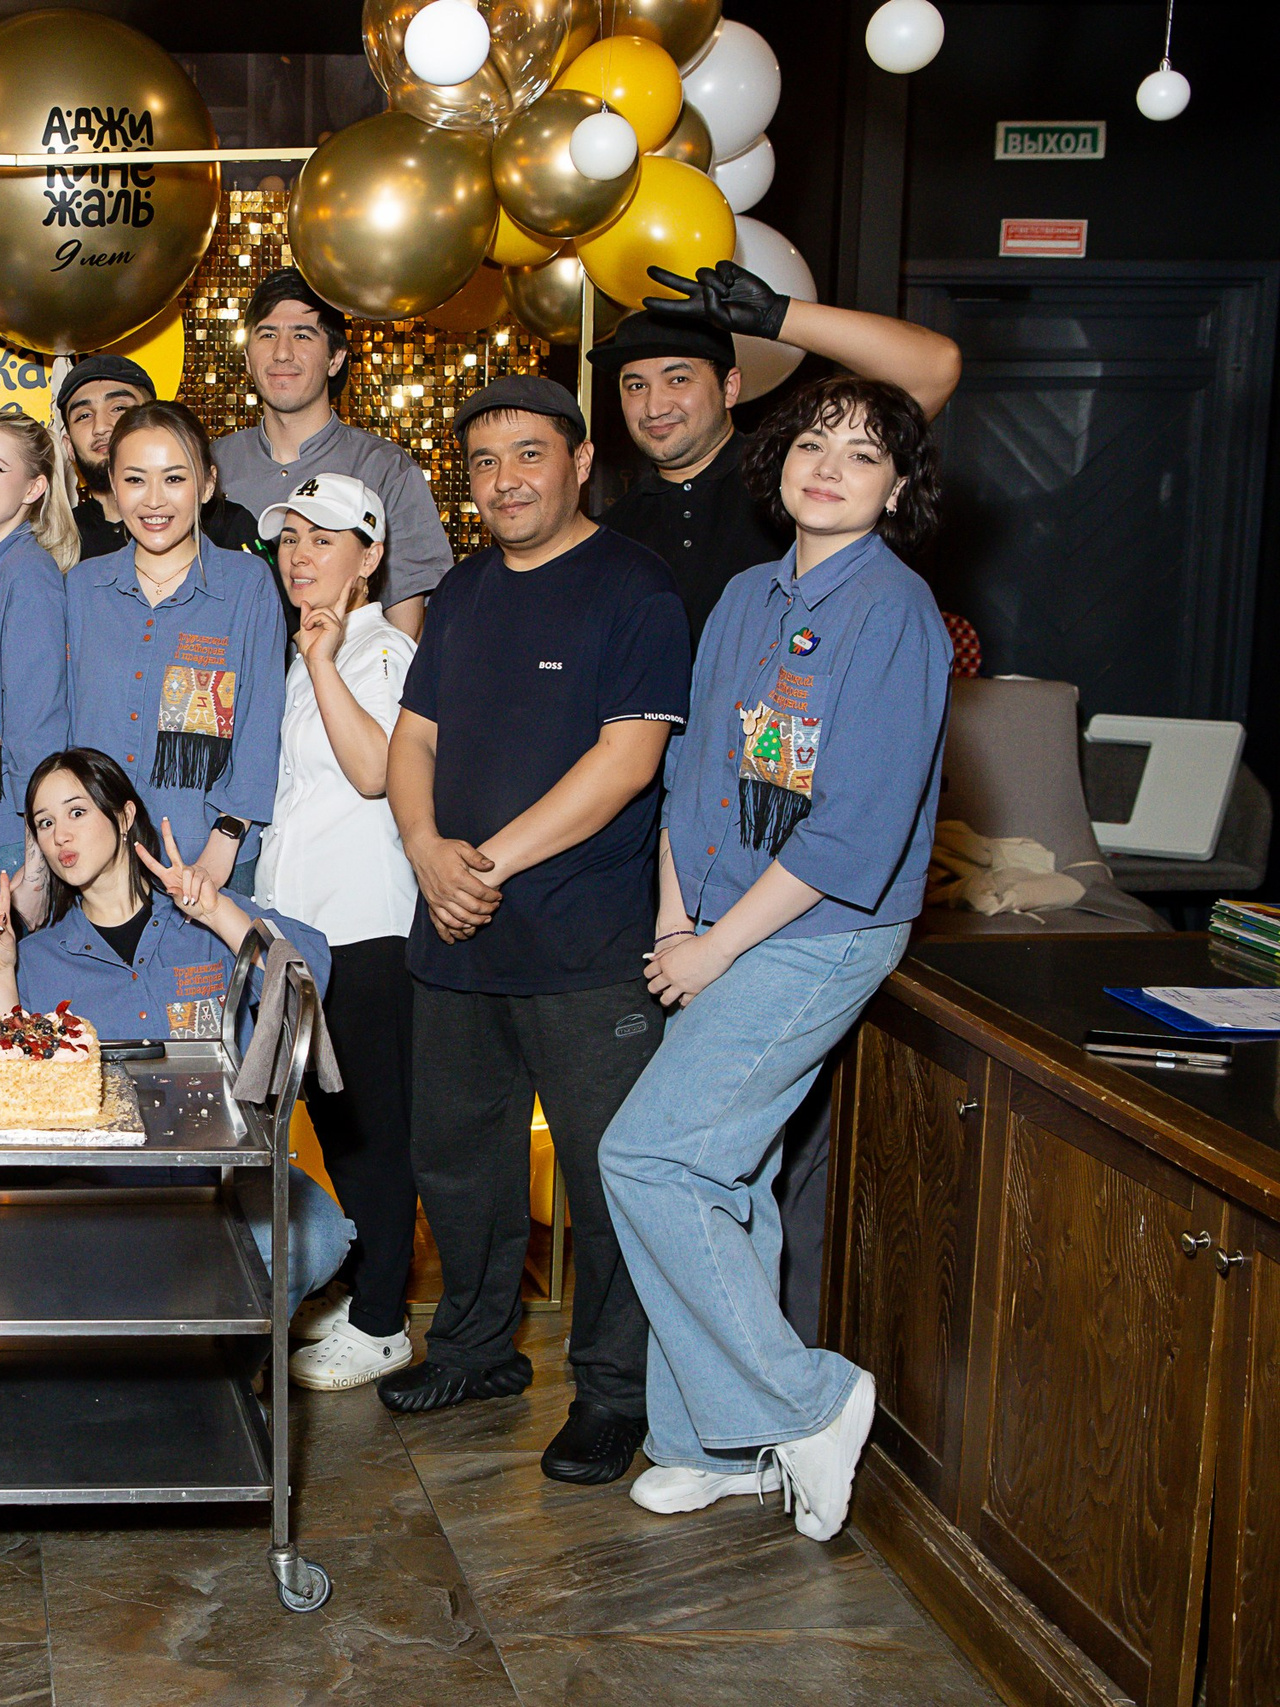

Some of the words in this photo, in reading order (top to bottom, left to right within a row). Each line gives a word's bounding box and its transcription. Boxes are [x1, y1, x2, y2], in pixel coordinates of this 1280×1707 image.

[1007, 132, 1094, 154] ВЫХОД
[50, 239, 83, 272] 9
[79, 250, 137, 267] лет
[538, 661, 563, 670] BOSS
[332, 1369, 381, 1388] Nordman
